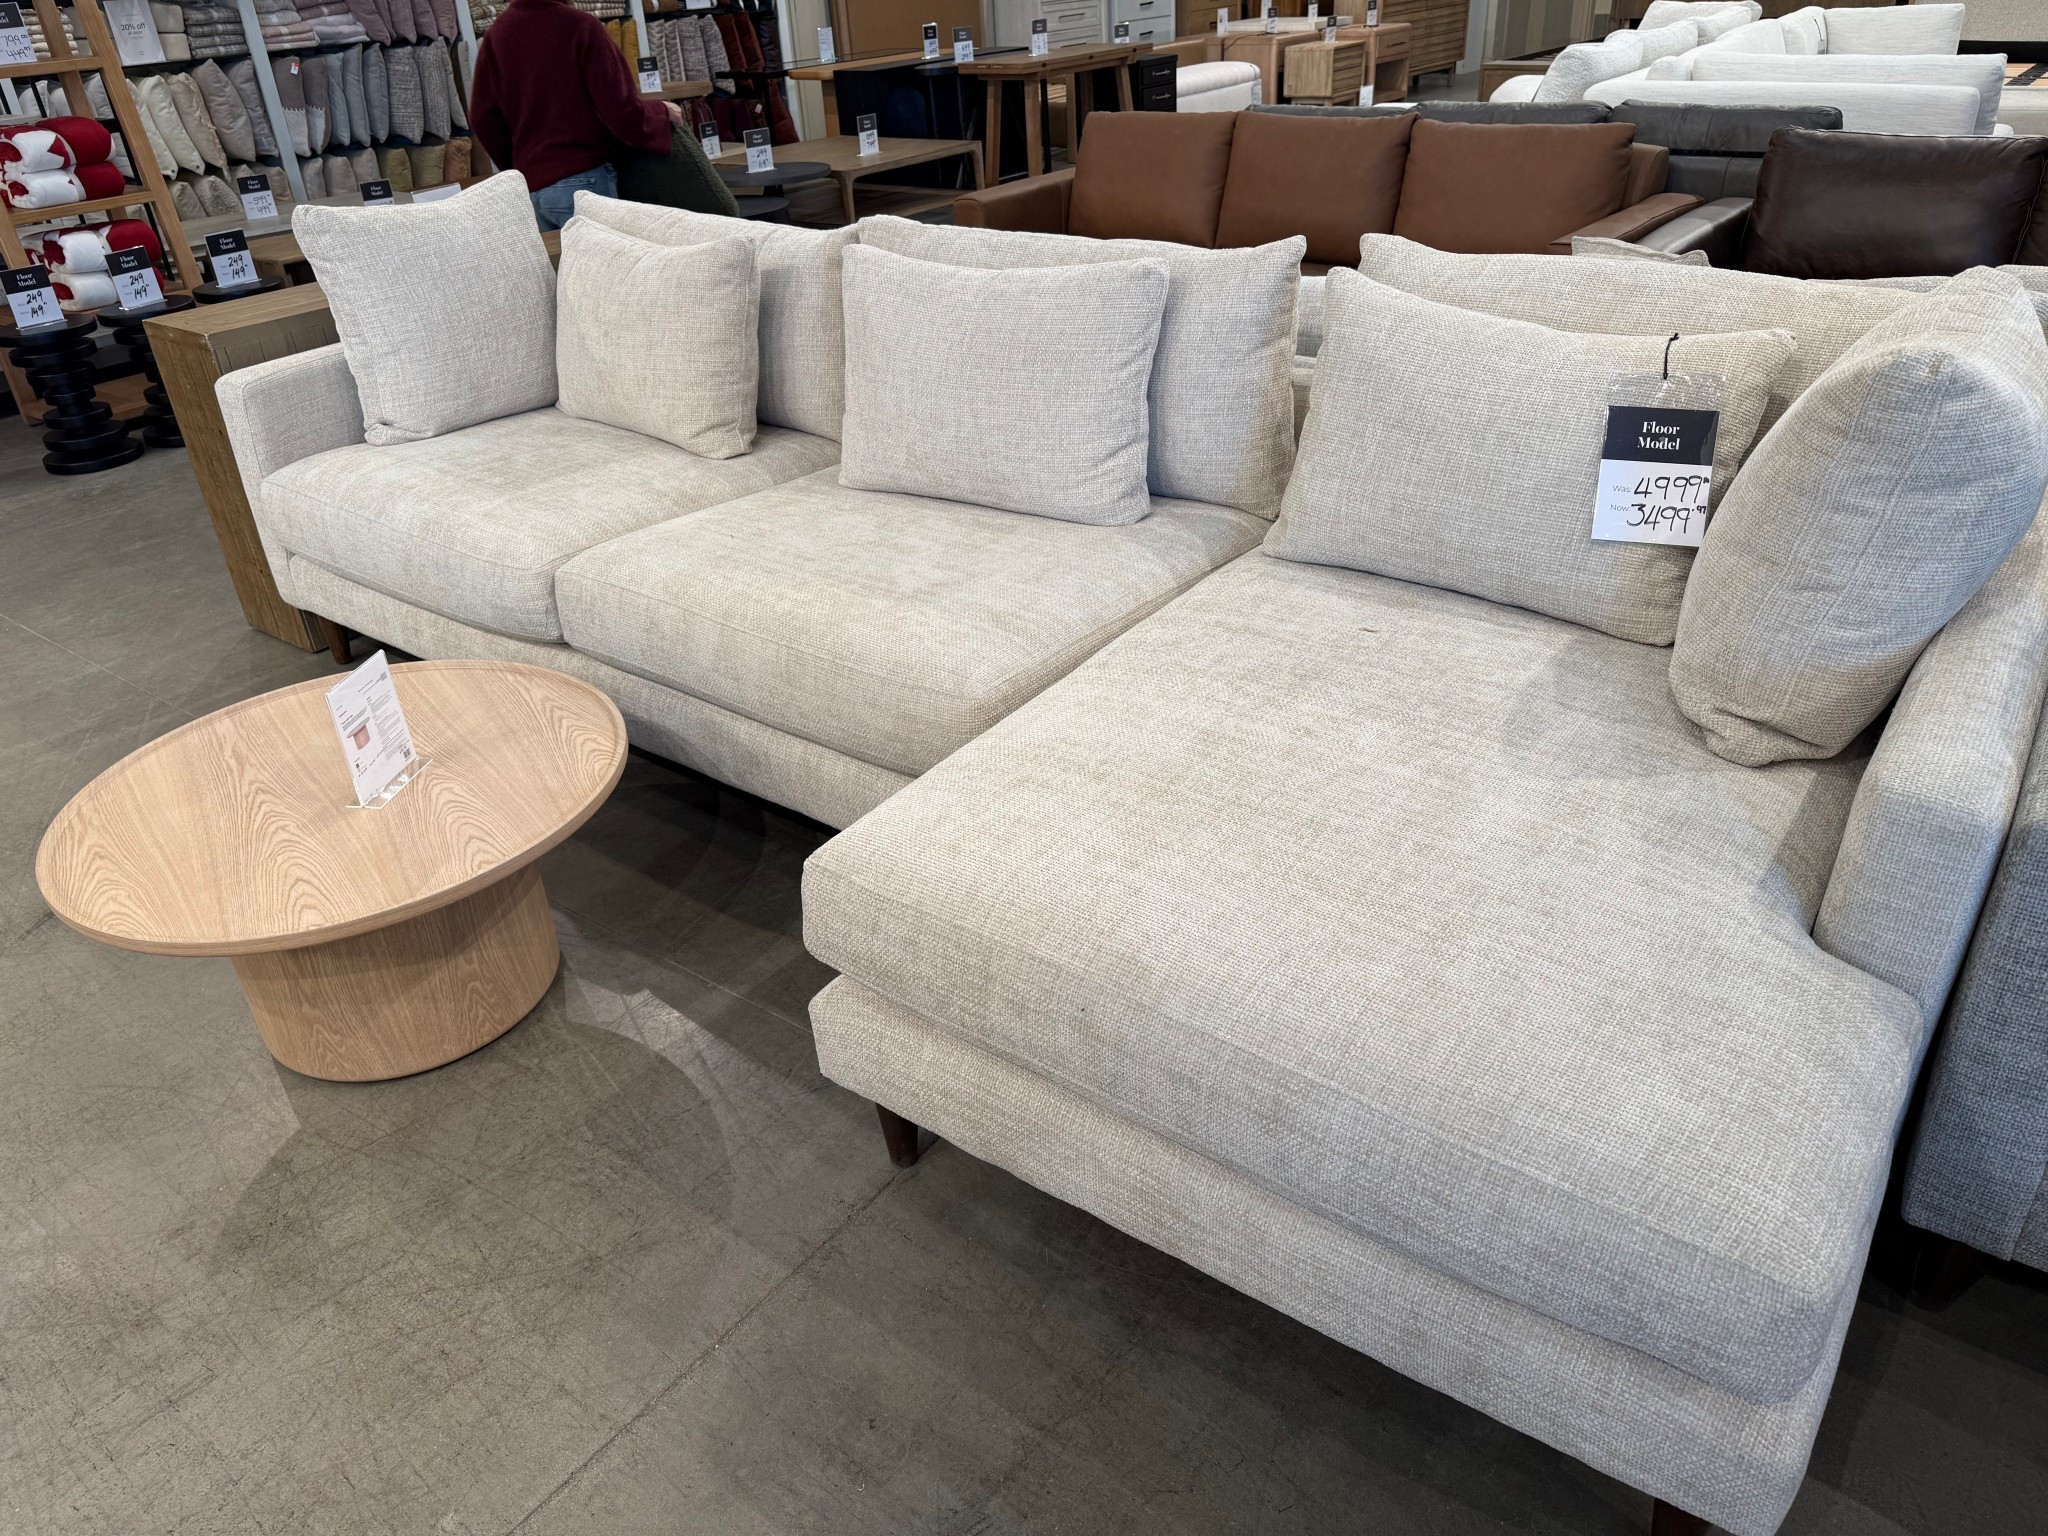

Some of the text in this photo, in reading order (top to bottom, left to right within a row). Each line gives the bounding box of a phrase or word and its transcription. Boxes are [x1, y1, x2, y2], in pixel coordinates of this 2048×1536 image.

[120, 21, 146, 31] 20% off
[119, 255, 135, 263] Floor
[120, 259, 139, 269] Model
[15, 273, 33, 281] Floor
[17, 278, 37, 287] Model
[1642, 421, 1681, 435] Floor
[1637, 436, 1680, 450] Model
[1612, 484, 1632, 494] Was:
[1610, 503, 1631, 513] Now:
